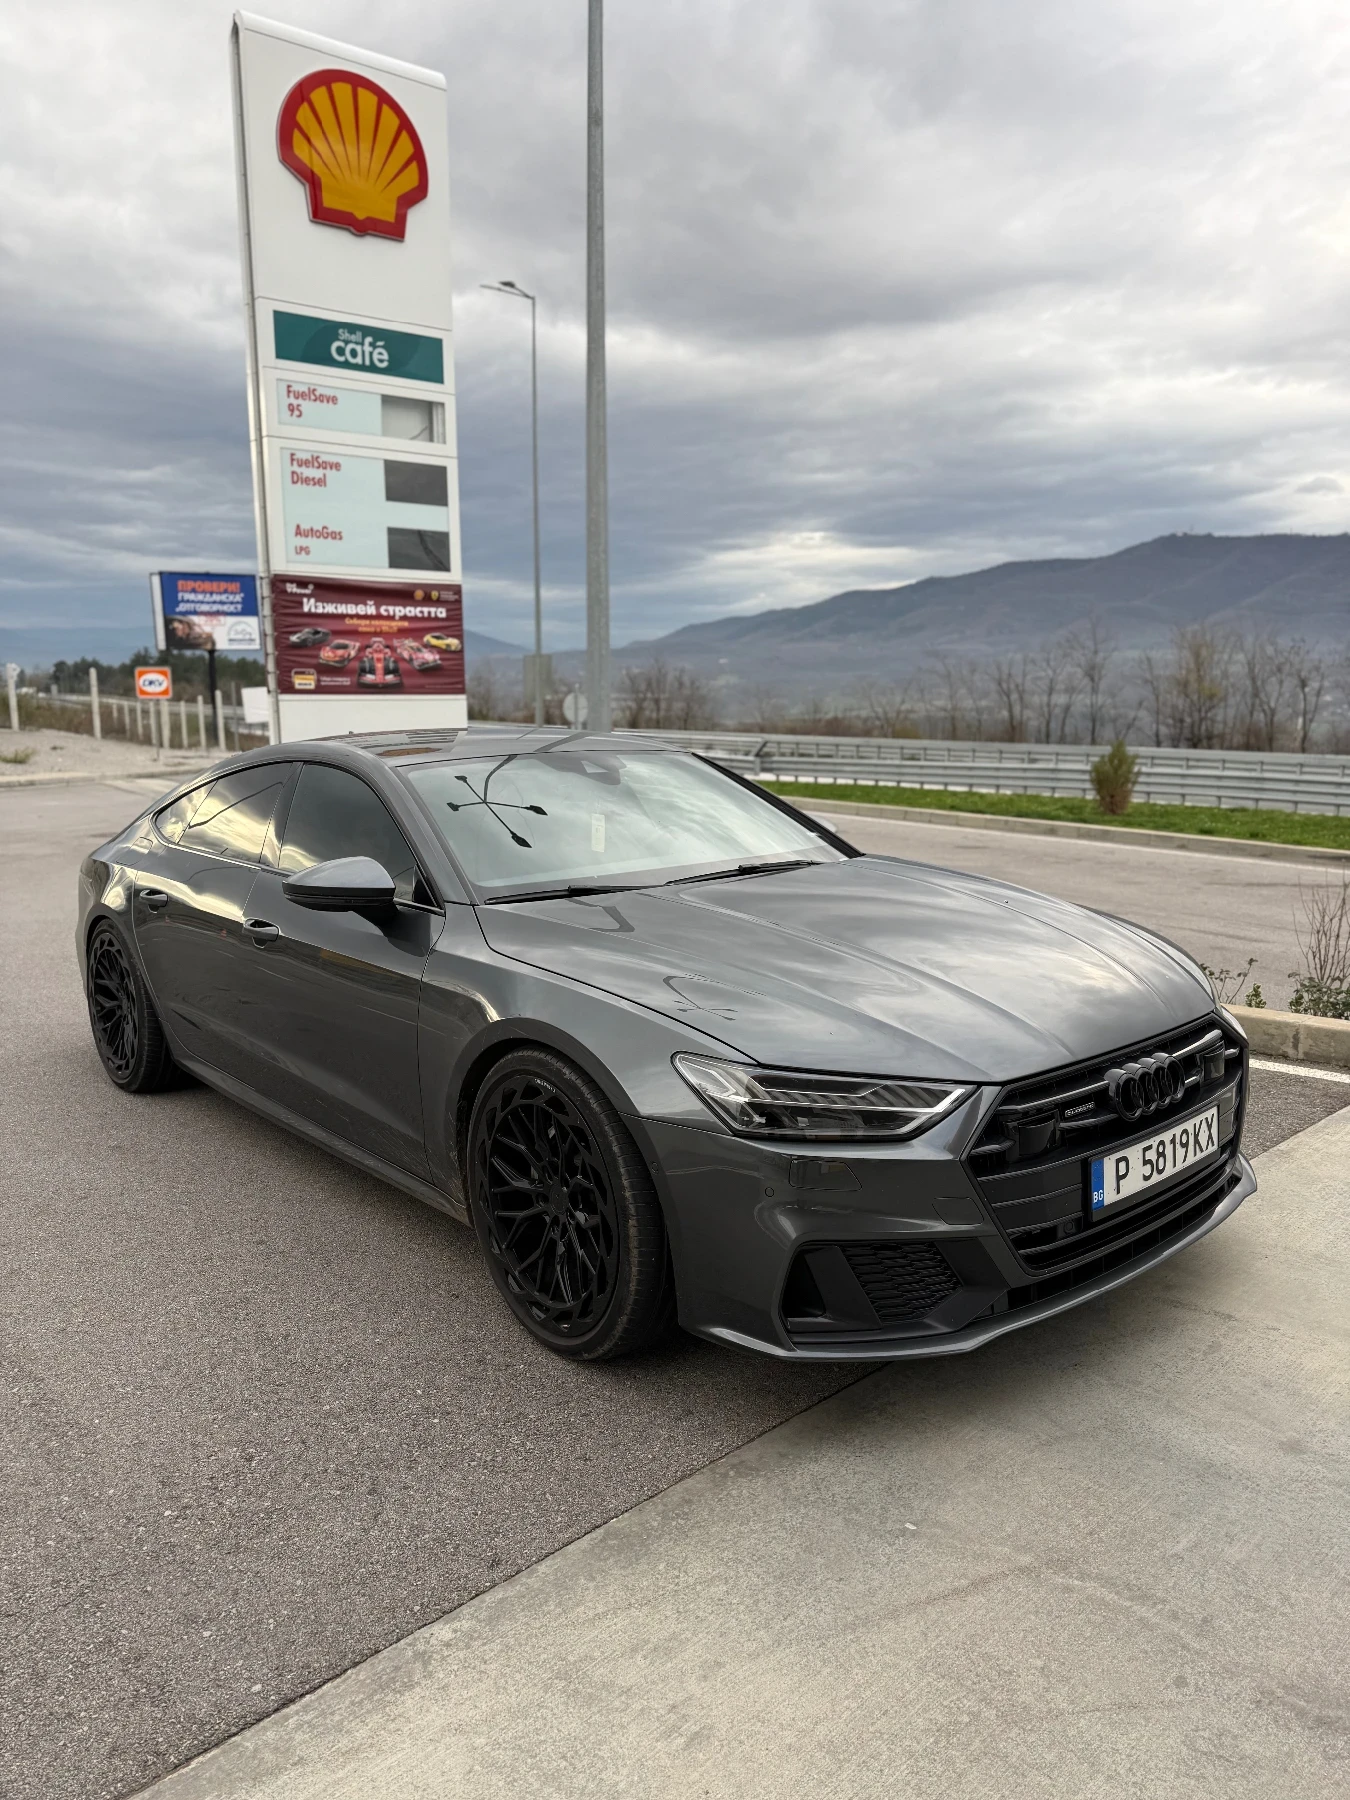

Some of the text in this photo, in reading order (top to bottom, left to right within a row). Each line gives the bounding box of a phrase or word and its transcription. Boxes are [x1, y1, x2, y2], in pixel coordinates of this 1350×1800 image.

[338, 328, 363, 343] Shell
[330, 336, 389, 368] café
[286, 384, 338, 405] FuelSave
[287, 403, 303, 418] 95
[290, 453, 342, 471] FuelSave
[290, 471, 327, 487] Diesel
[294, 524, 343, 541] AutoGas
[295, 545, 311, 555] LPG
[177, 580, 241, 592] ПРОВЕРИ!
[302, 598, 447, 620] Изживей страстта
[1115, 1113, 1215, 1195] P 5819KX
[1093, 1190, 1104, 1203] BG
